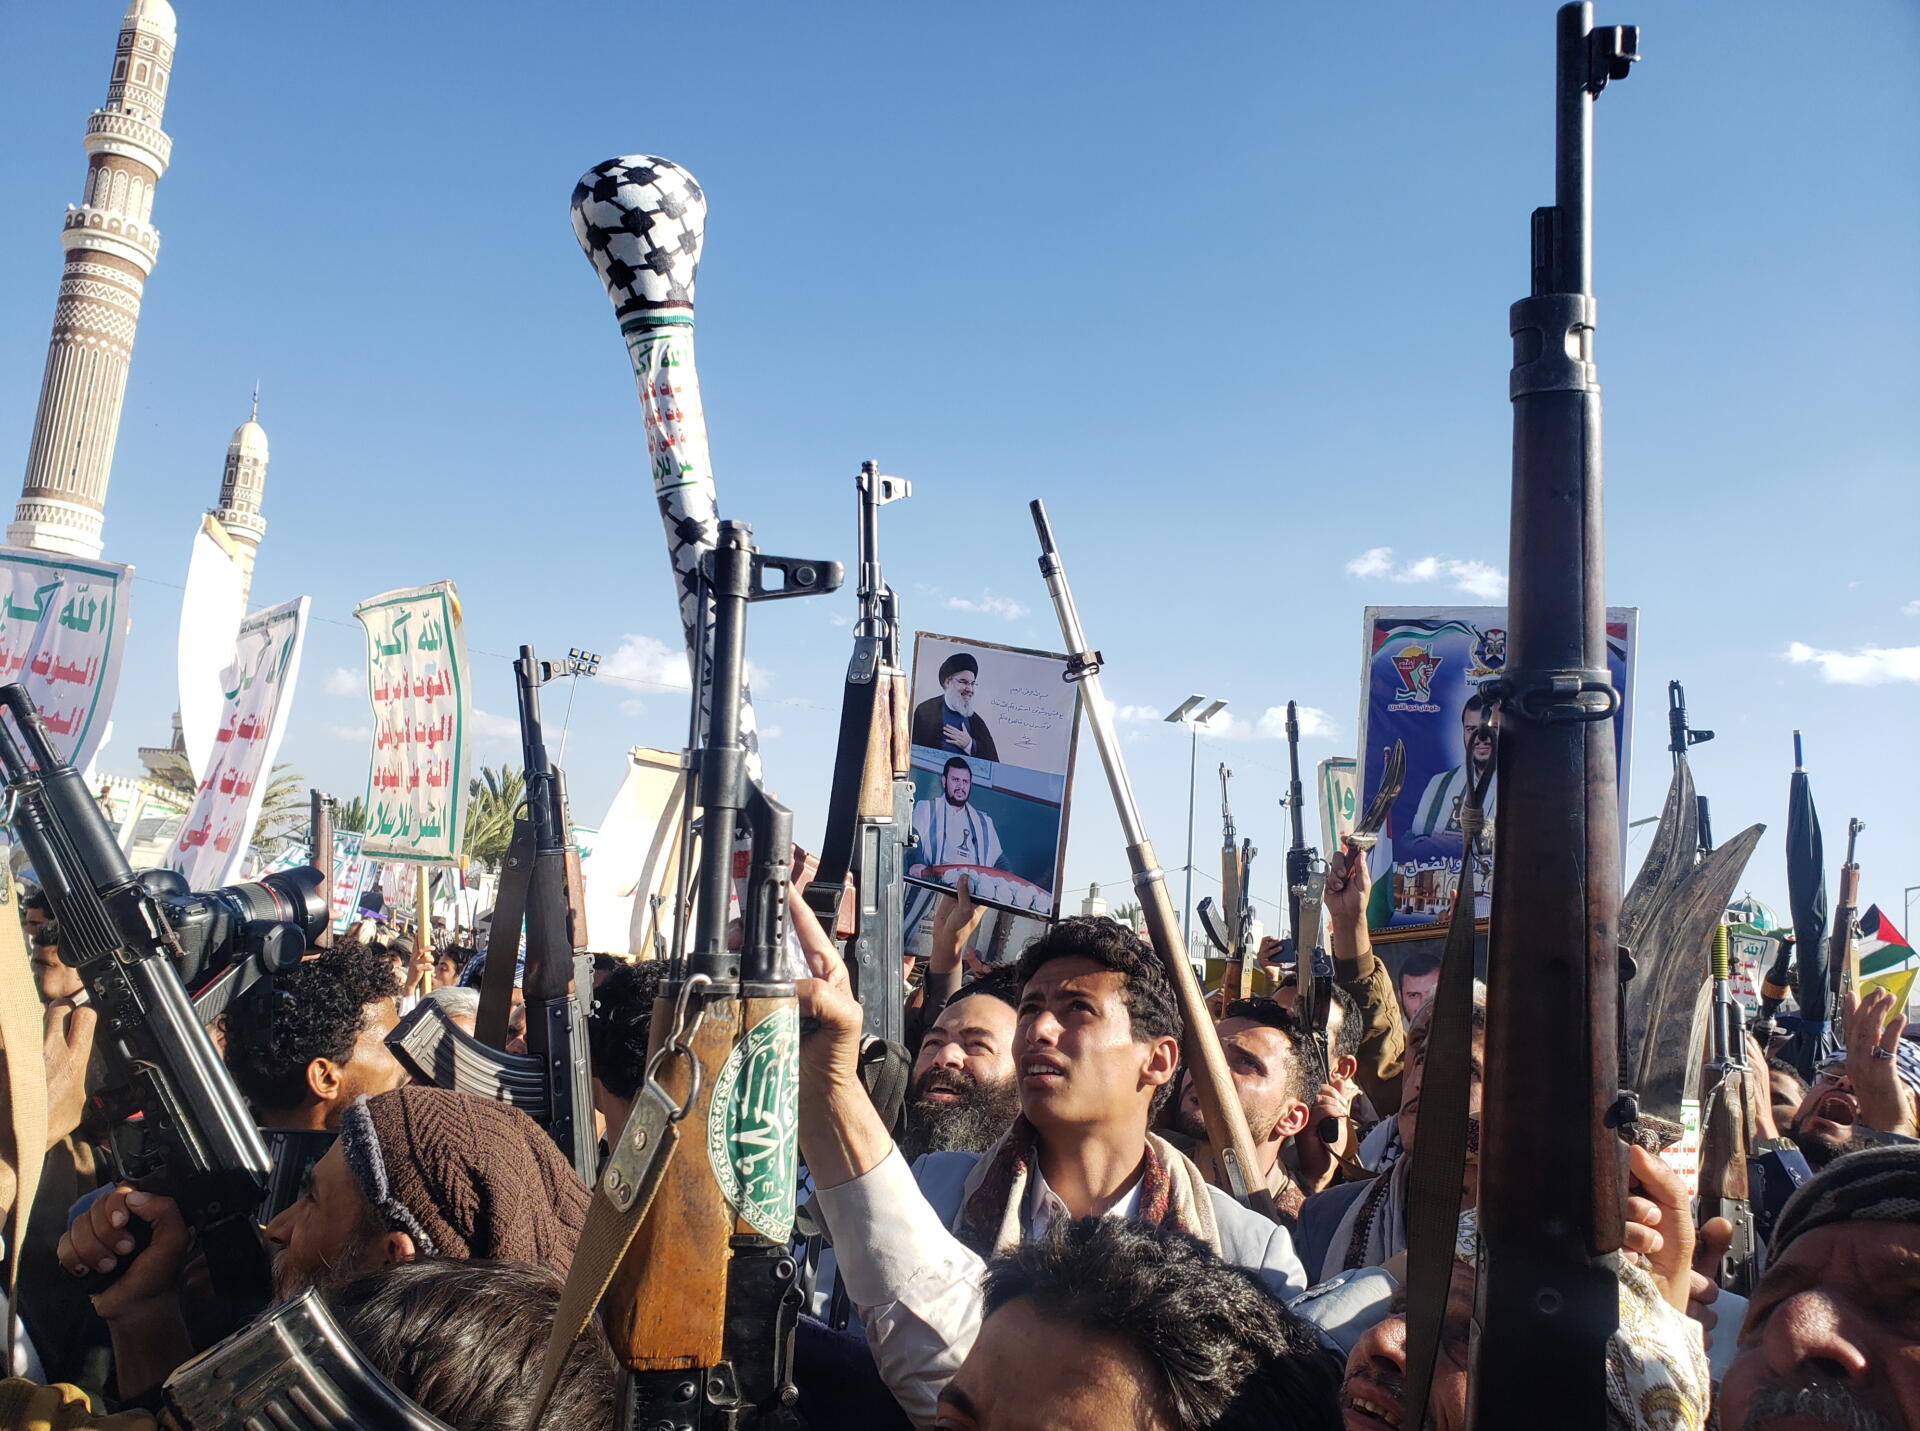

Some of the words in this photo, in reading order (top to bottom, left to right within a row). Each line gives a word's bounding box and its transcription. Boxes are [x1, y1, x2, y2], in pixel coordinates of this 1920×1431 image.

[58, 585, 107, 635] الله
[372, 606, 412, 670] أكبر
[417, 608, 442, 652] الله
[31, 651, 98, 687] الموت
[413, 668, 451, 704] الموت
[415, 712, 453, 750] الموت
[1404, 856, 1464, 878] والفعل
